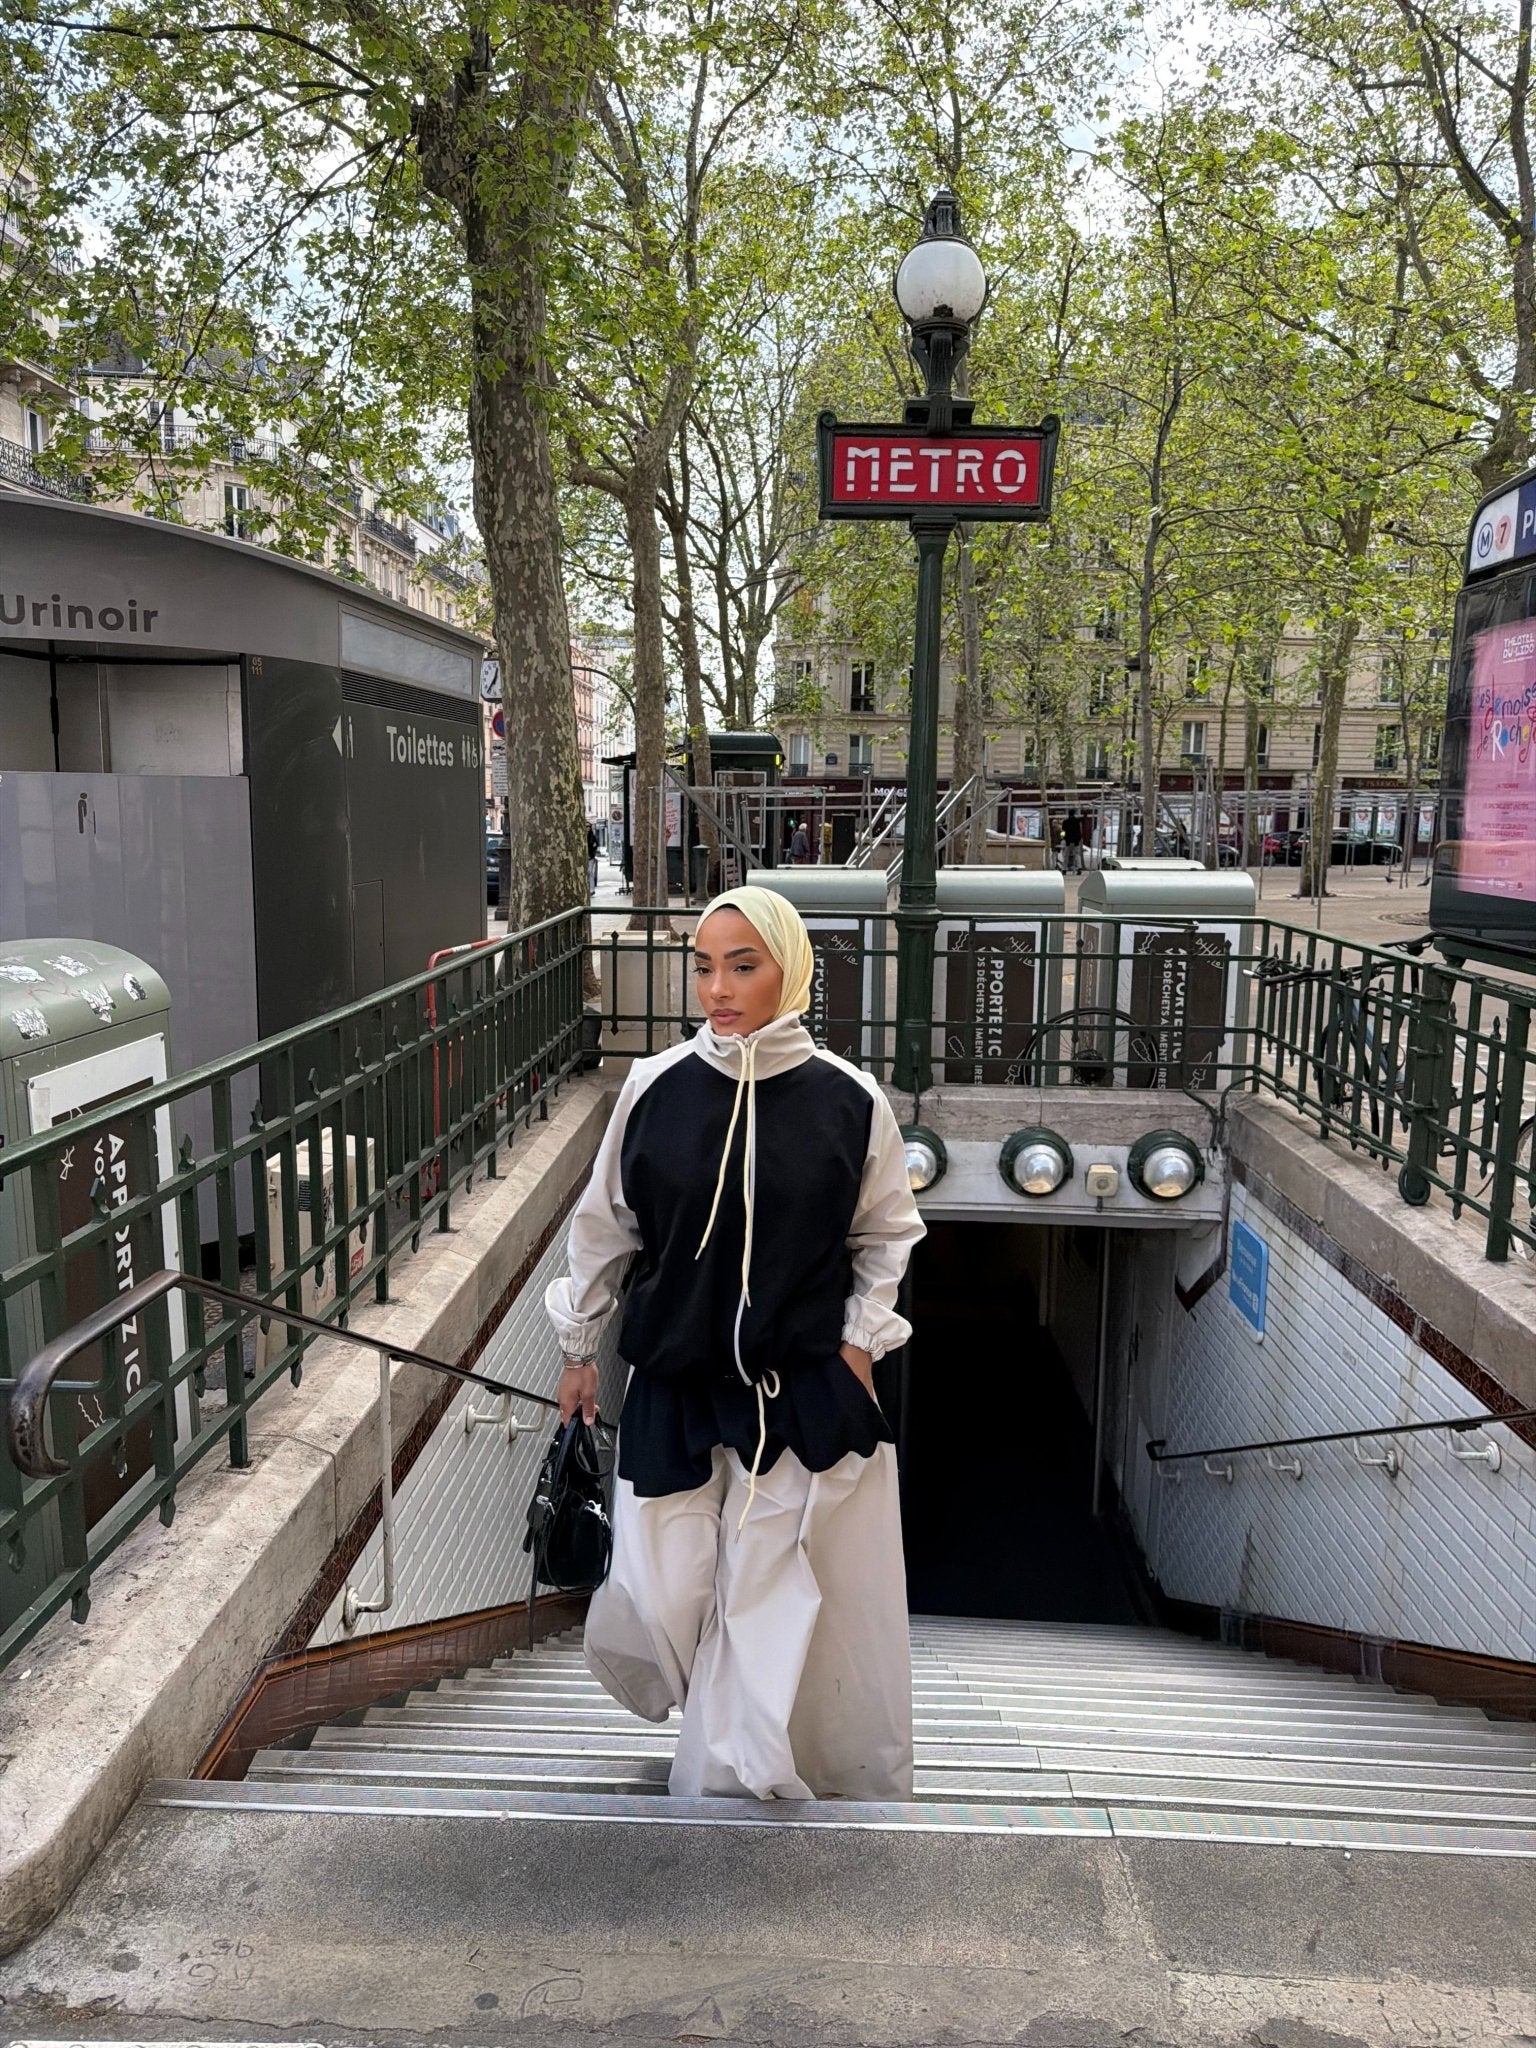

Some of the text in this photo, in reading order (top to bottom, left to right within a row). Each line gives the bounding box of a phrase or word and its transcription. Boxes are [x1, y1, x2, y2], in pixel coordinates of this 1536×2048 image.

[845, 446, 1027, 494] METRO
[1500, 521, 1508, 544] 7
[1522, 507, 1536, 539] P
[0, 593, 158, 633] Urinoir
[386, 724, 453, 767] Toilettes
[988, 1040, 1002, 1057] IC
[108, 1133, 142, 1395] APPORTZ IC
